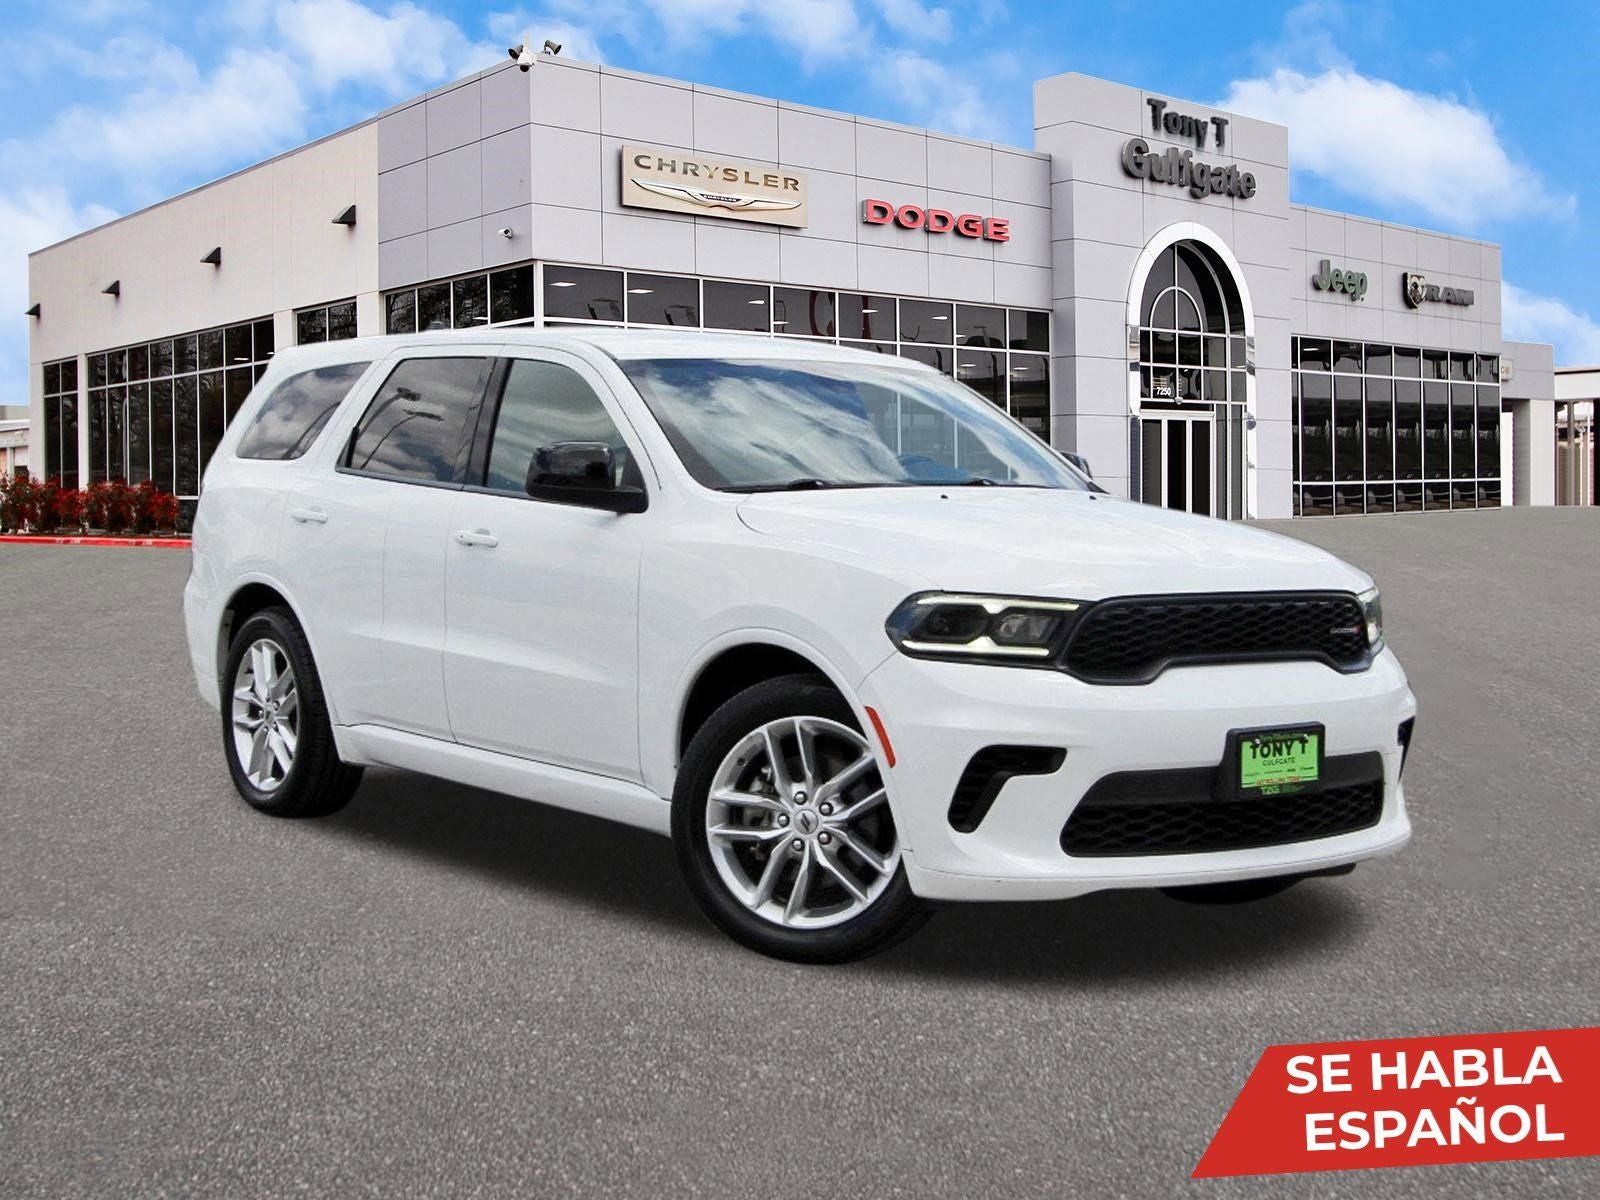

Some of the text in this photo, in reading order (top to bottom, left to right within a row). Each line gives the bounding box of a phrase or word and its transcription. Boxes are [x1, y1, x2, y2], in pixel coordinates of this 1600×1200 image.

[1147, 98, 1229, 147] Tony T
[633, 154, 800, 191] CHRYSLER
[1122, 138, 1257, 199] Gulfgate
[863, 199, 1011, 242] DODGE
[1312, 259, 1367, 301] Jeep
[1425, 284, 1475, 306] RAM
[1156, 386, 1172, 396] 7250
[1250, 737, 1309, 759] TONY T
